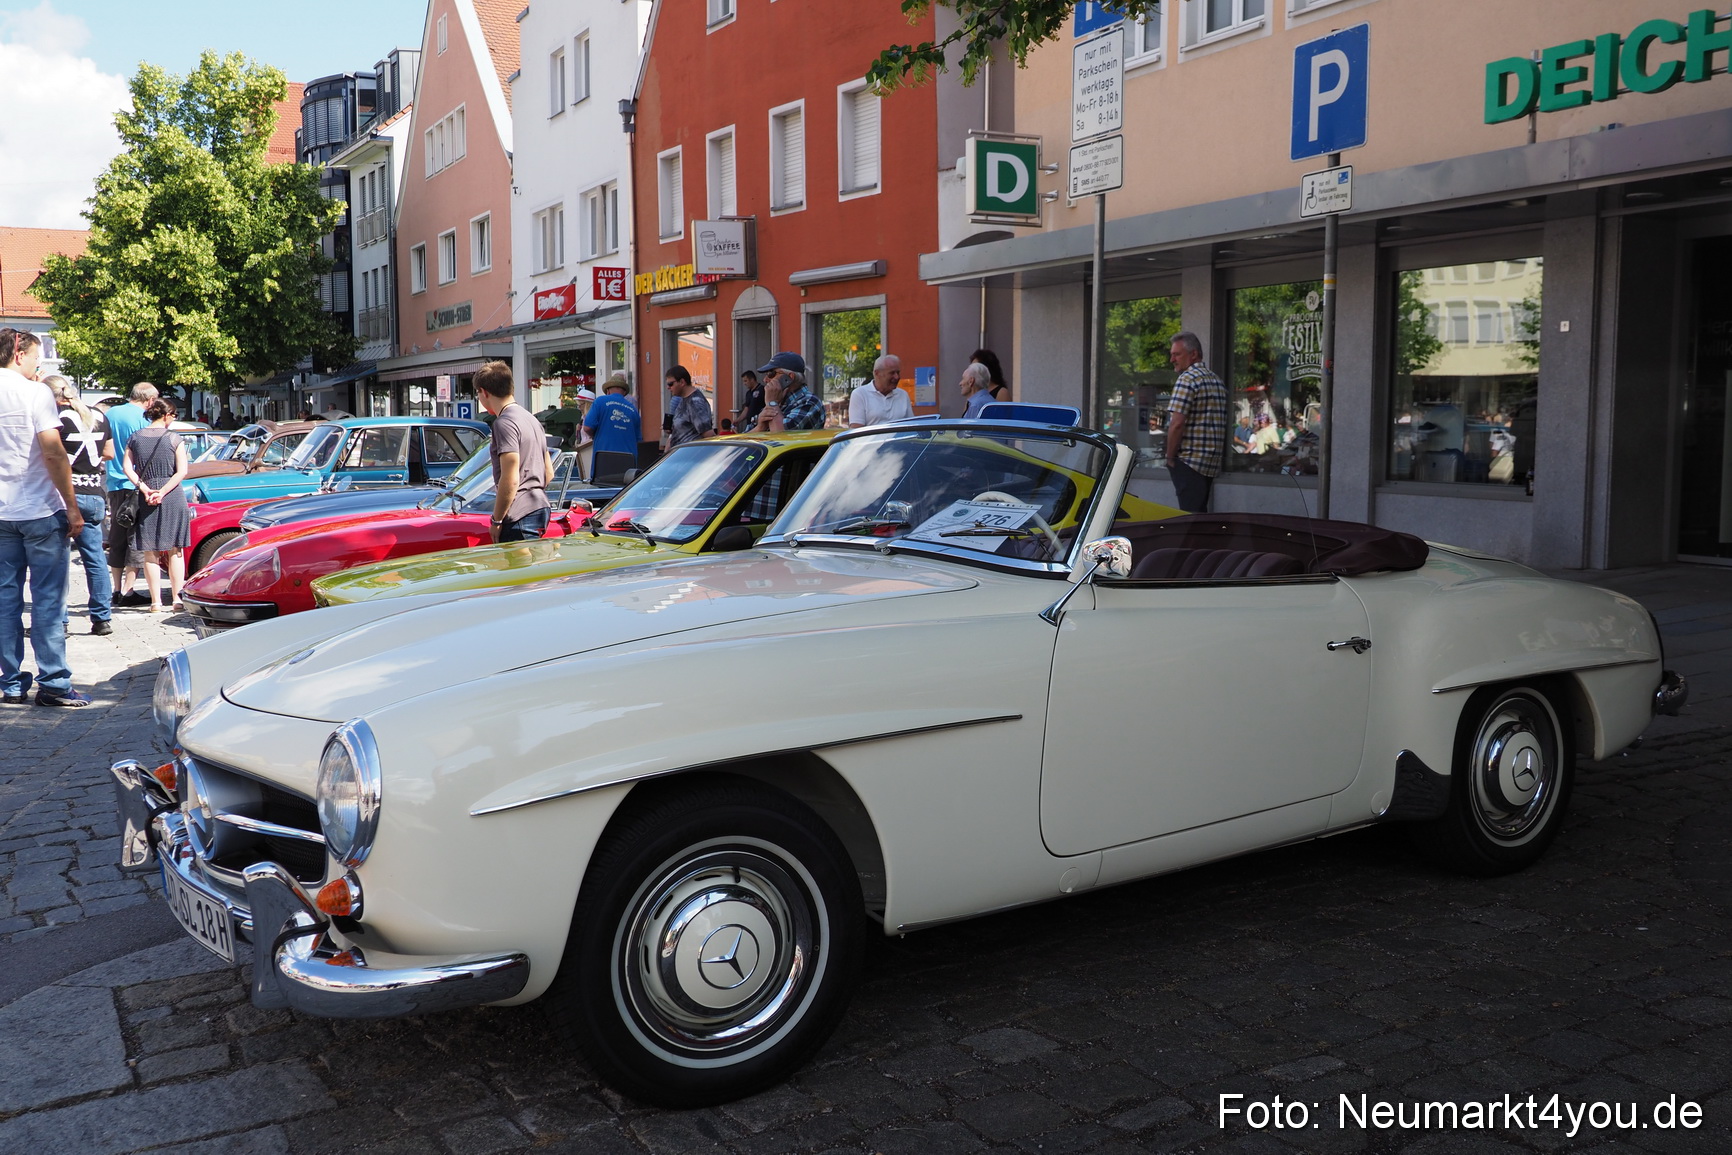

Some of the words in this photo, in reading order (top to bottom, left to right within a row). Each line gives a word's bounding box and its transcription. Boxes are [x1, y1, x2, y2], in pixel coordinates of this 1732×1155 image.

[1084, 48, 1096, 61] nur
[1099, 41, 1112, 55] mit
[1078, 57, 1118, 80] Parkschein
[1080, 77, 1114, 96] werktags
[1308, 49, 1350, 142] P
[1075, 98, 1097, 115] Mo-Fr
[1076, 119, 1085, 131] Sa
[986, 151, 1029, 203] D
[713, 242, 741, 251] KAFFEE
[597, 269, 622, 278] ALLES
[635, 272, 653, 296] DER
[655, 264, 694, 292] BÄCKER
[597, 278, 622, 298] 1€
[1281, 319, 1323, 353] FESTIV
[1288, 350, 1323, 366] SELECTI
[460, 406, 469, 419] P
[980, 513, 1012, 526] 376
[179, 886, 197, 932] SL
[196, 898, 230, 953] 18H
